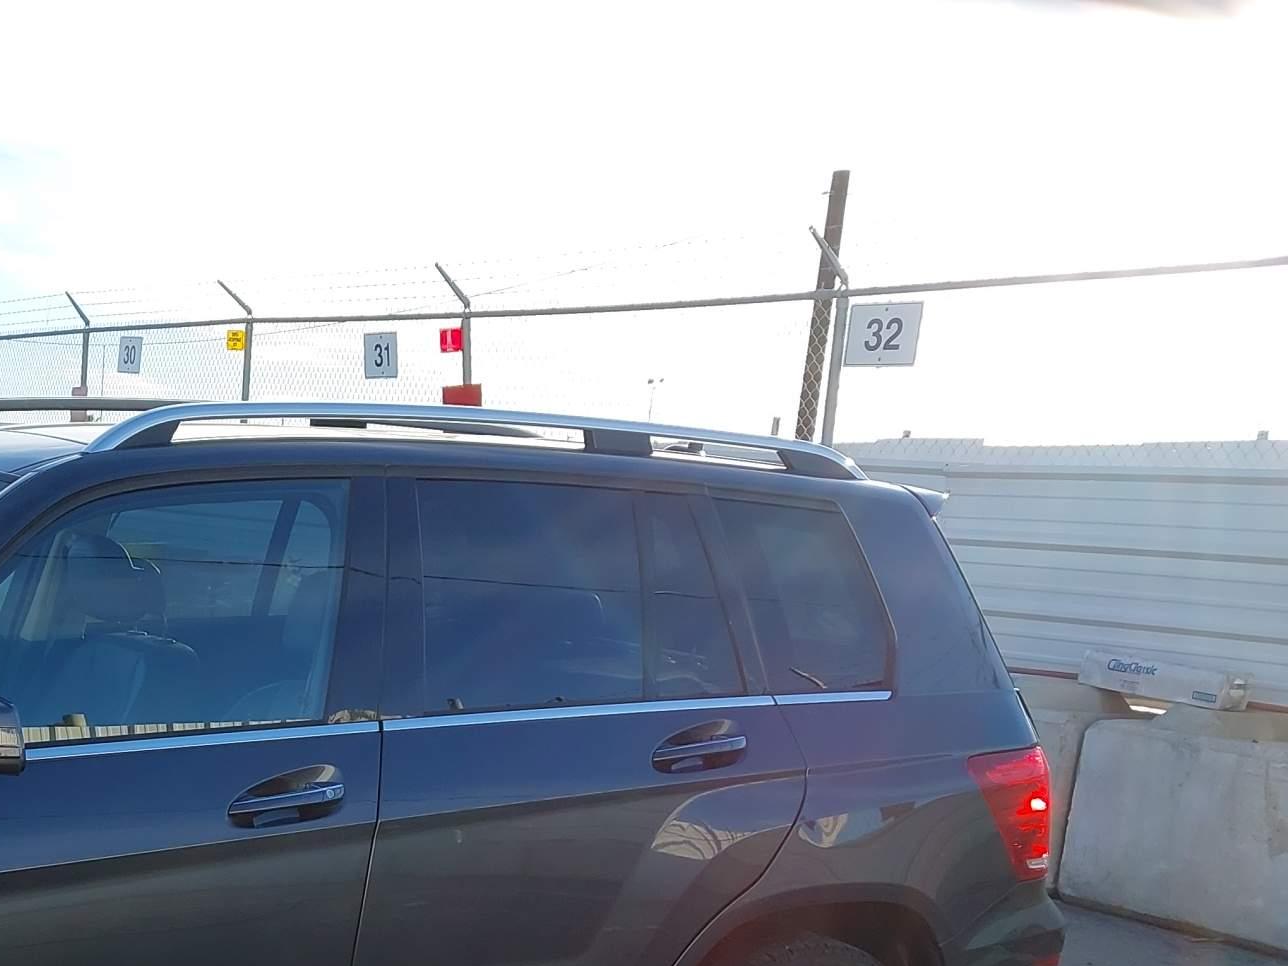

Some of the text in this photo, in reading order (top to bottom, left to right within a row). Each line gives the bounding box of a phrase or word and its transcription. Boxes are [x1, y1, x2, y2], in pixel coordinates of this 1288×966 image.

[864, 317, 903, 352] 32
[123, 345, 136, 364] 30
[374, 342, 390, 367] 31
